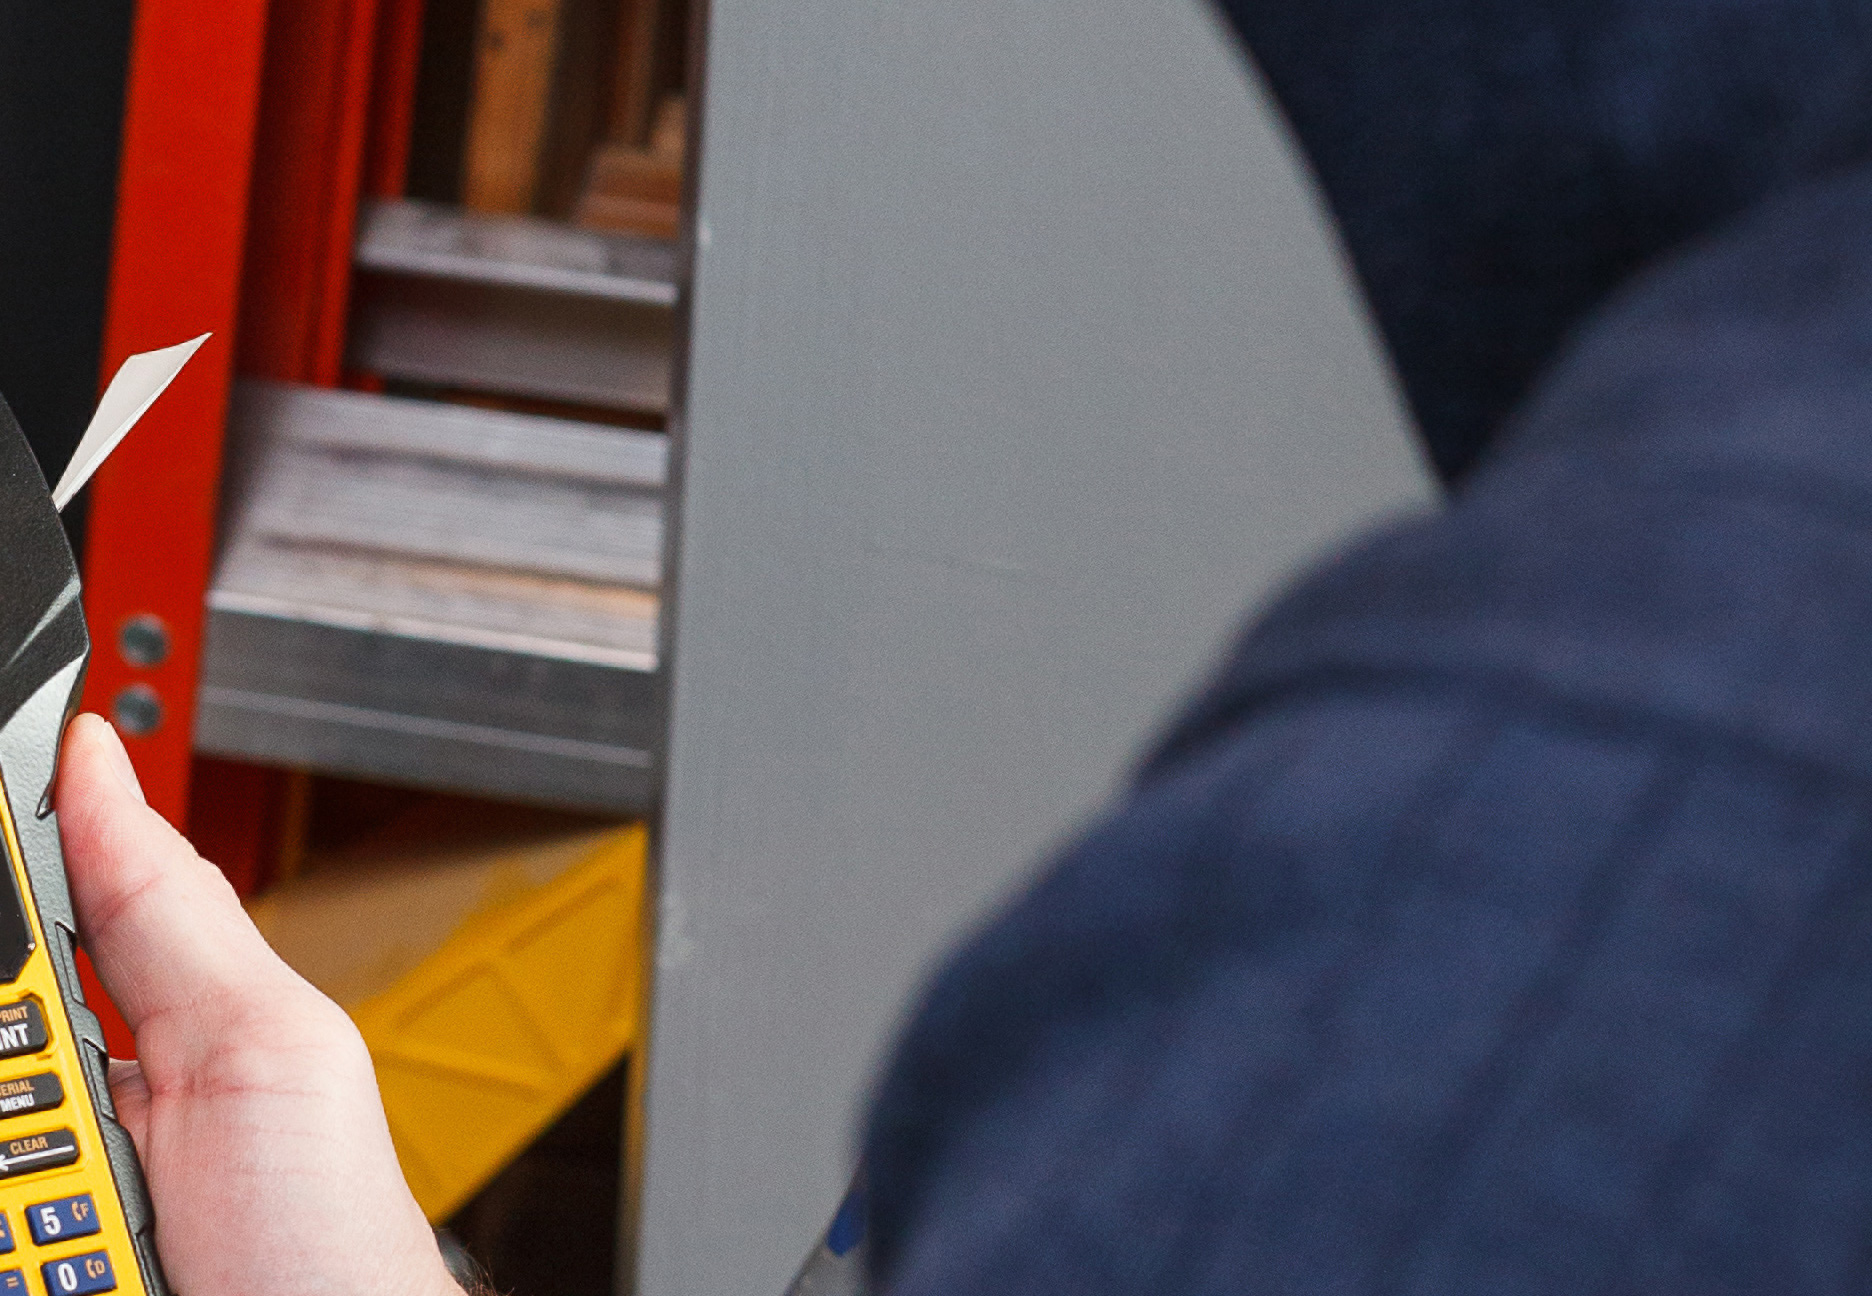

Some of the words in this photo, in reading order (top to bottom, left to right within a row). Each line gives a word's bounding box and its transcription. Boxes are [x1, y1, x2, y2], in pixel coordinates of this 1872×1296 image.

[0, 1093, 35, 1112] MENU
[10, 1136, 48, 1155] CLEAR
[39, 1206, 62, 1236] 5
[57, 1262, 78, 1292] 0
